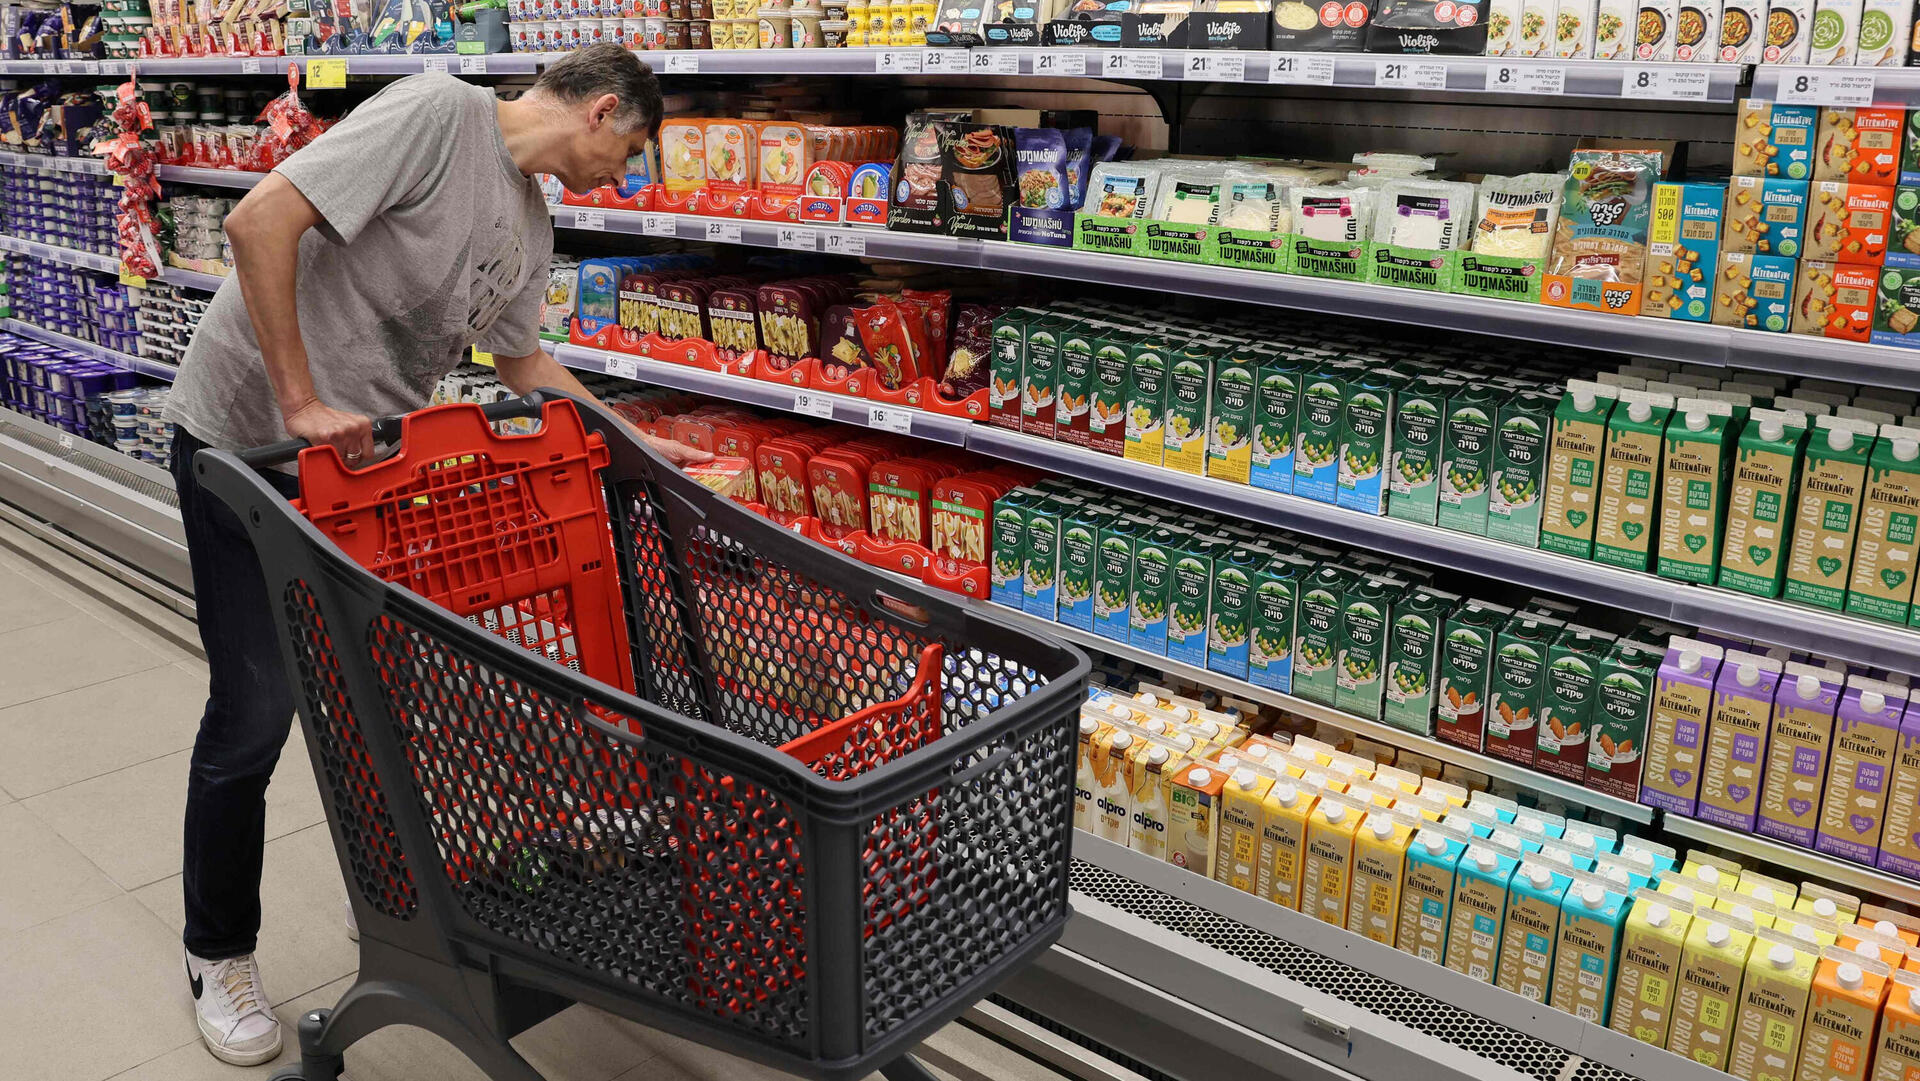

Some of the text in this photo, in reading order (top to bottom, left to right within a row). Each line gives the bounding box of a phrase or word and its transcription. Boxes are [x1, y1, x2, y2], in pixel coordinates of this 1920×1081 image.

[1010, 27, 1034, 40] Violife
[1053, 23, 1088, 43] Violife
[1207, 22, 1242, 40] Violife
[1399, 34, 1440, 52] Violife
[884, 54, 891, 65] 5
[928, 52, 941, 64] 23
[976, 54, 989, 66] 26
[1040, 56, 1052, 68] 21
[1110, 56, 1123, 68] 21
[1192, 58, 1206, 70] 21
[1278, 58, 1292, 71] 21
[1385, 64, 1400, 79] 21
[1499, 68, 1510, 83] 8
[1637, 72, 1649, 88] 8
[1795, 76, 1808, 92] 8
[1591, 202, 1625, 214] טירת
[1658, 197, 1676, 206] חסכון
[578, 212, 587, 222] 25
[1593, 211, 1618, 226] צבי
[1658, 208, 1674, 220] 500
[710, 224, 720, 234] 23
[782, 231, 792, 241] 14
[1042, 230, 1066, 239] NoTuna
[1608, 229, 1630, 240] הסדרה
[830, 236, 838, 246] 17
[1578, 284, 1596, 293] הסדרה
[1604, 289, 1631, 300] טירת
[1606, 298, 1626, 308] צבי
[610, 358, 618, 368] 19
[1032, 357, 1052, 368] שקדים
[1100, 372, 1121, 384] שקדים
[1140, 381, 1157, 392] סויה
[798, 396, 808, 406] 19
[1225, 396, 1244, 407] סויה
[873, 410, 884, 421] 16
[1355, 423, 1374, 435] סויה
[1408, 430, 1428, 442] סויה
[1556, 436, 1596, 454] ALTERNATIVE
[1508, 449, 1531, 462] סויה
[1738, 466, 1784, 487] ALTERNATIVE
[1546, 454, 1568, 527] SOY DRINK
[1732, 486, 1752, 515] SOY
[1870, 488, 1920, 509] ALTERNATIVE
[1864, 506, 1886, 538] SOY
[1663, 508, 1680, 553] DRINK
[1001, 534, 1016, 544] סויה
[1726, 518, 1747, 564] DRINK
[1107, 563, 1123, 574] סויה
[1856, 540, 1879, 588] DRINK
[1182, 584, 1199, 596] סויה
[1310, 617, 1328, 629] סויה
[1403, 643, 1422, 656] סויה
[1453, 656, 1478, 670] שקדים
[1504, 672, 1532, 686] שקדים
[1556, 686, 1584, 700] שקדים
[1606, 703, 1635, 717] שקדים
[1717, 710, 1761, 731] ALTERNATIVE
[1650, 712, 1672, 783] ALMONDS
[1766, 740, 1792, 812] ALMONDS
[1825, 754, 1854, 829] ALMONDS
[1172, 791, 1197, 807] BIO
[1097, 798, 1126, 817] alpro
[1887, 770, 1916, 847] ALMONDS
[1100, 814, 1120, 829] שקדים
[1134, 812, 1164, 832] alpro
[1220, 824, 1232, 848] OAT
[1307, 858, 1320, 883] OAT
[1354, 876, 1367, 901] OAT
[1620, 966, 1640, 993] SOY
[1685, 968, 1731, 996] ALTERNATIVE
[1826, 1008, 1846, 1018] תנובה
[1740, 1010, 1762, 1044] SOY
[1812, 1012, 1864, 1040] ALTERNATIVE
